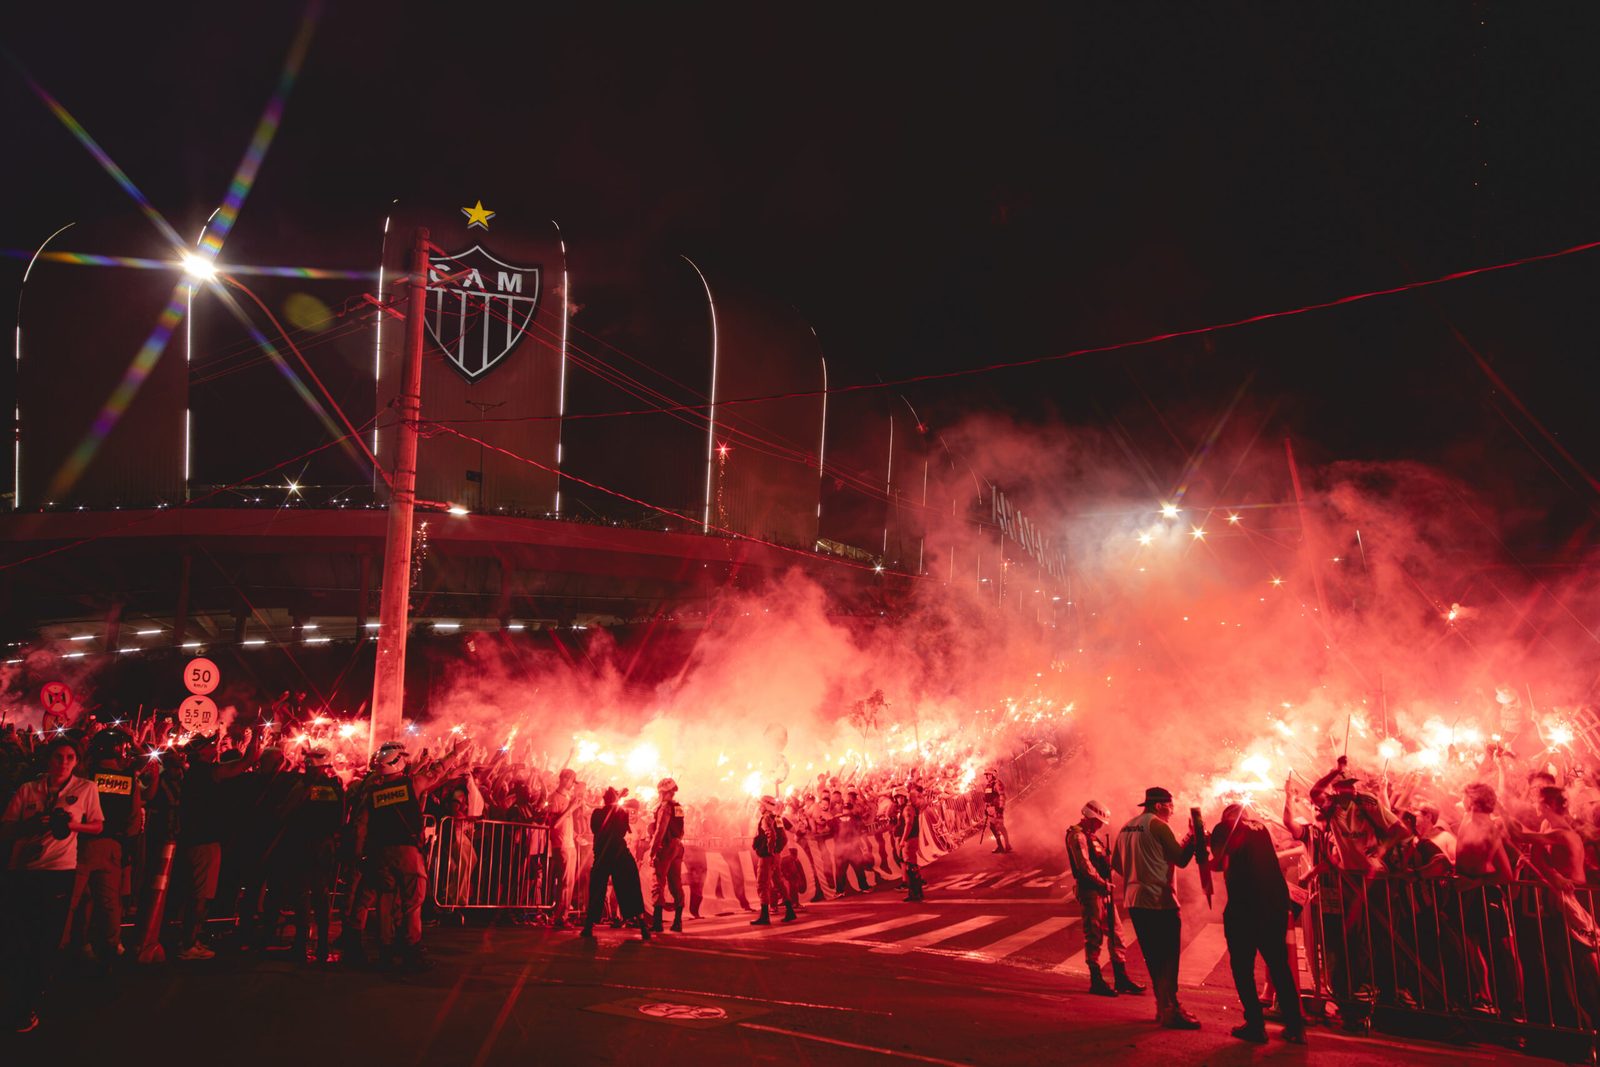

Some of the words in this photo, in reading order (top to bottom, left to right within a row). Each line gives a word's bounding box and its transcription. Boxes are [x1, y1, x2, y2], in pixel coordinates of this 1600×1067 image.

[429, 263, 523, 293] CAM
[192, 668, 210, 683] 50
[97, 777, 128, 790] PMMG
[376, 789, 404, 802] PMMG
